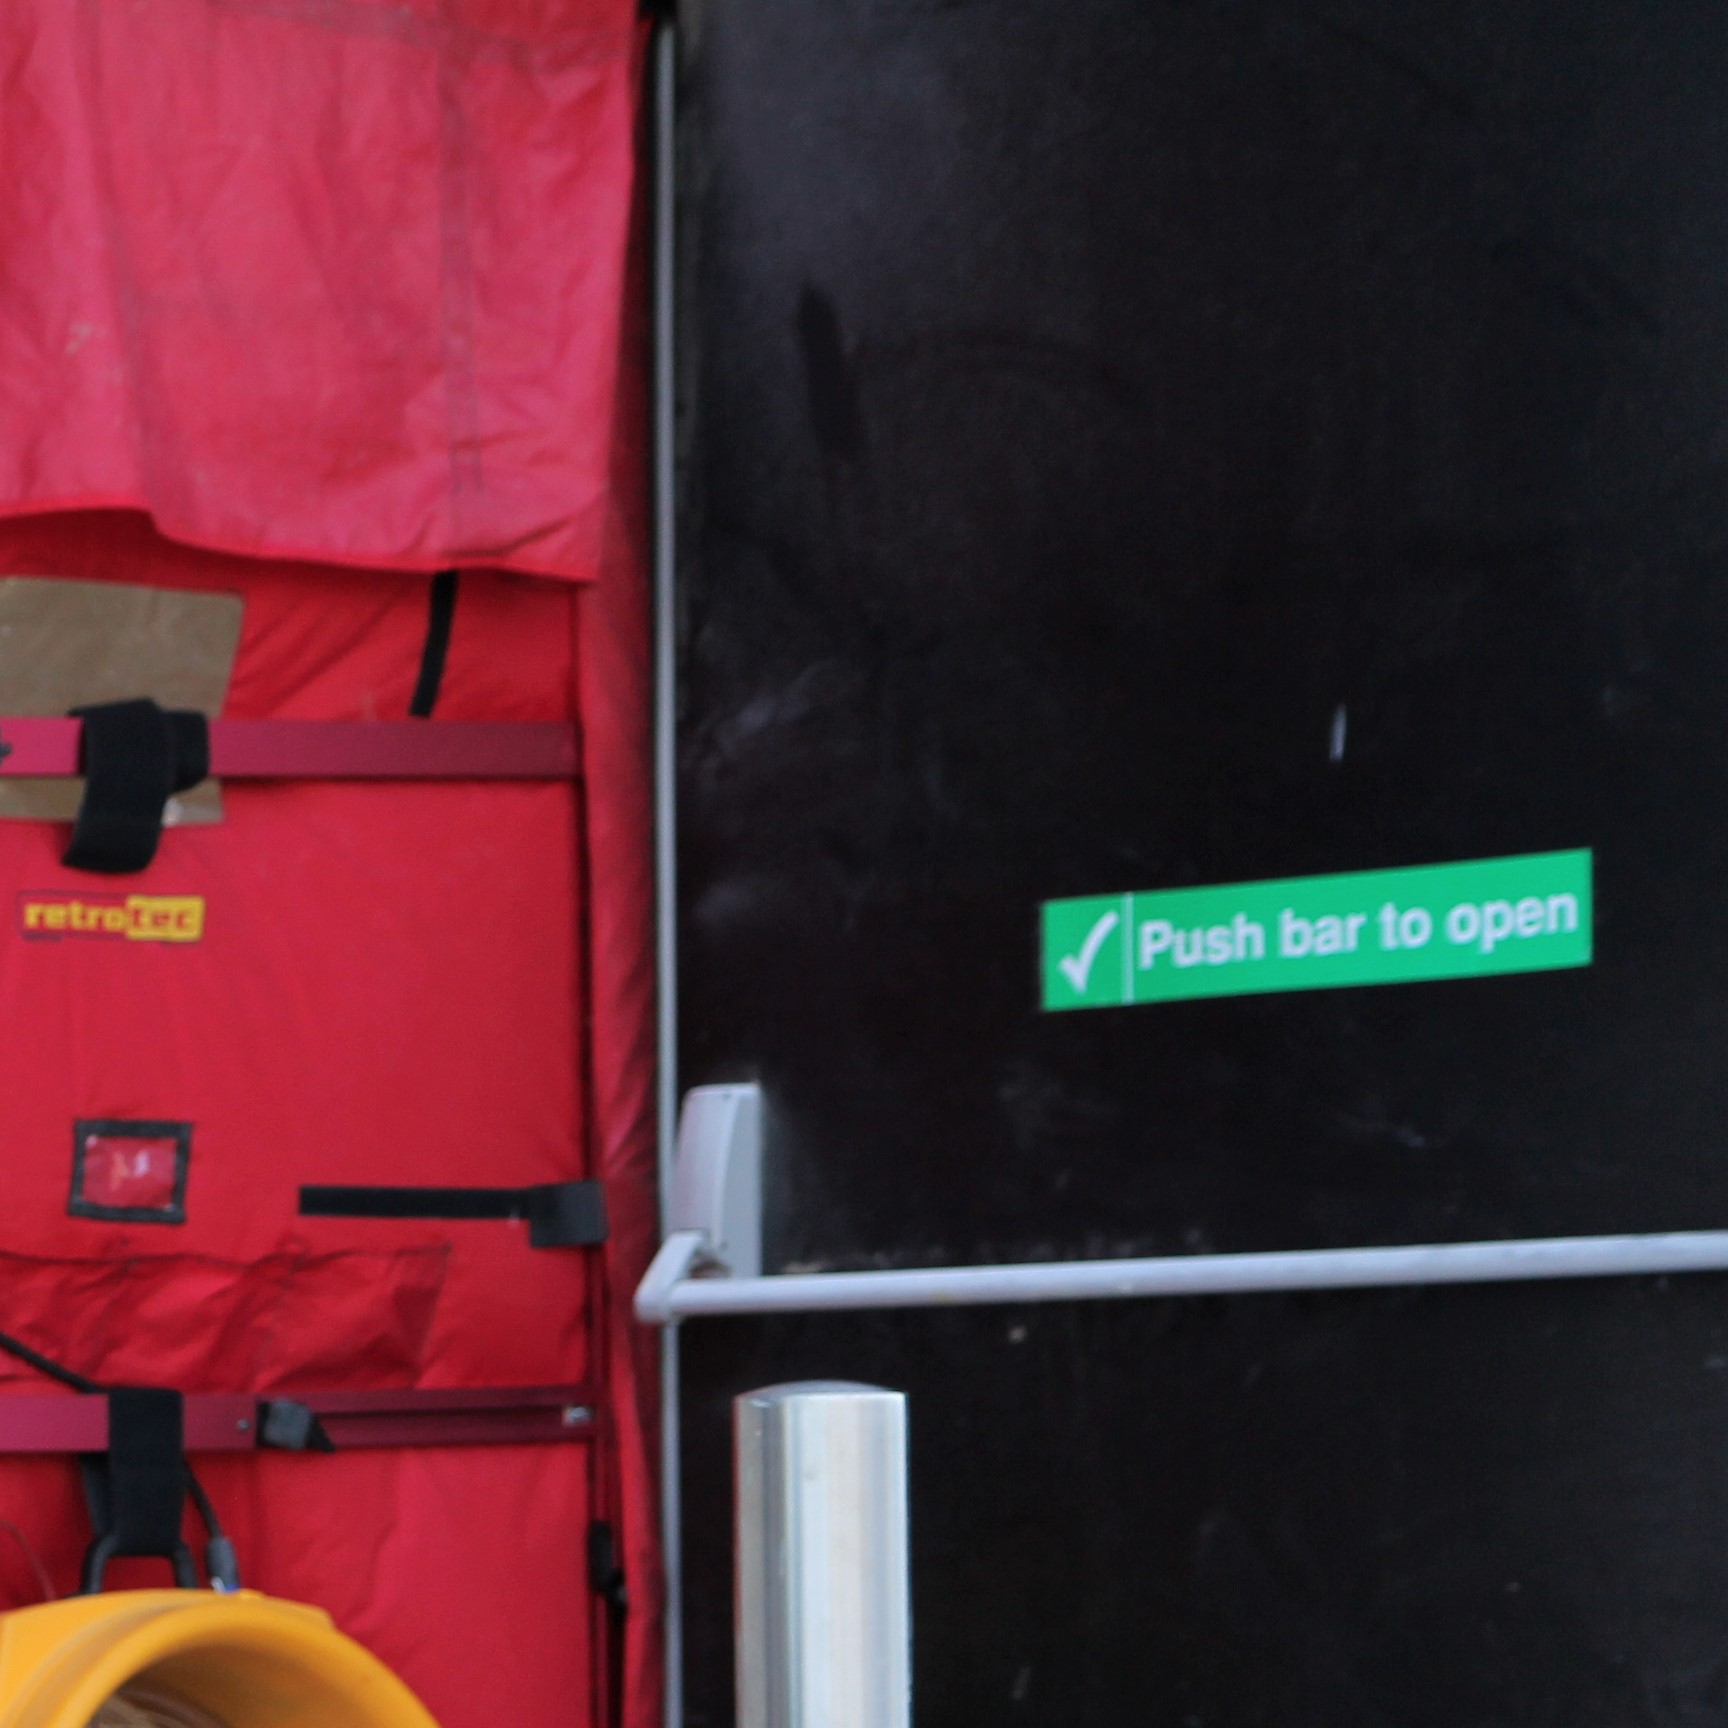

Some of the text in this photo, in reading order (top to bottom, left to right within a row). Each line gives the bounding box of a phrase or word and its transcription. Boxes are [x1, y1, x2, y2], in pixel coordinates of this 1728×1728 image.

[25, 899, 200, 937] retrotec
[1139, 892, 1578, 970] Push bar to open
